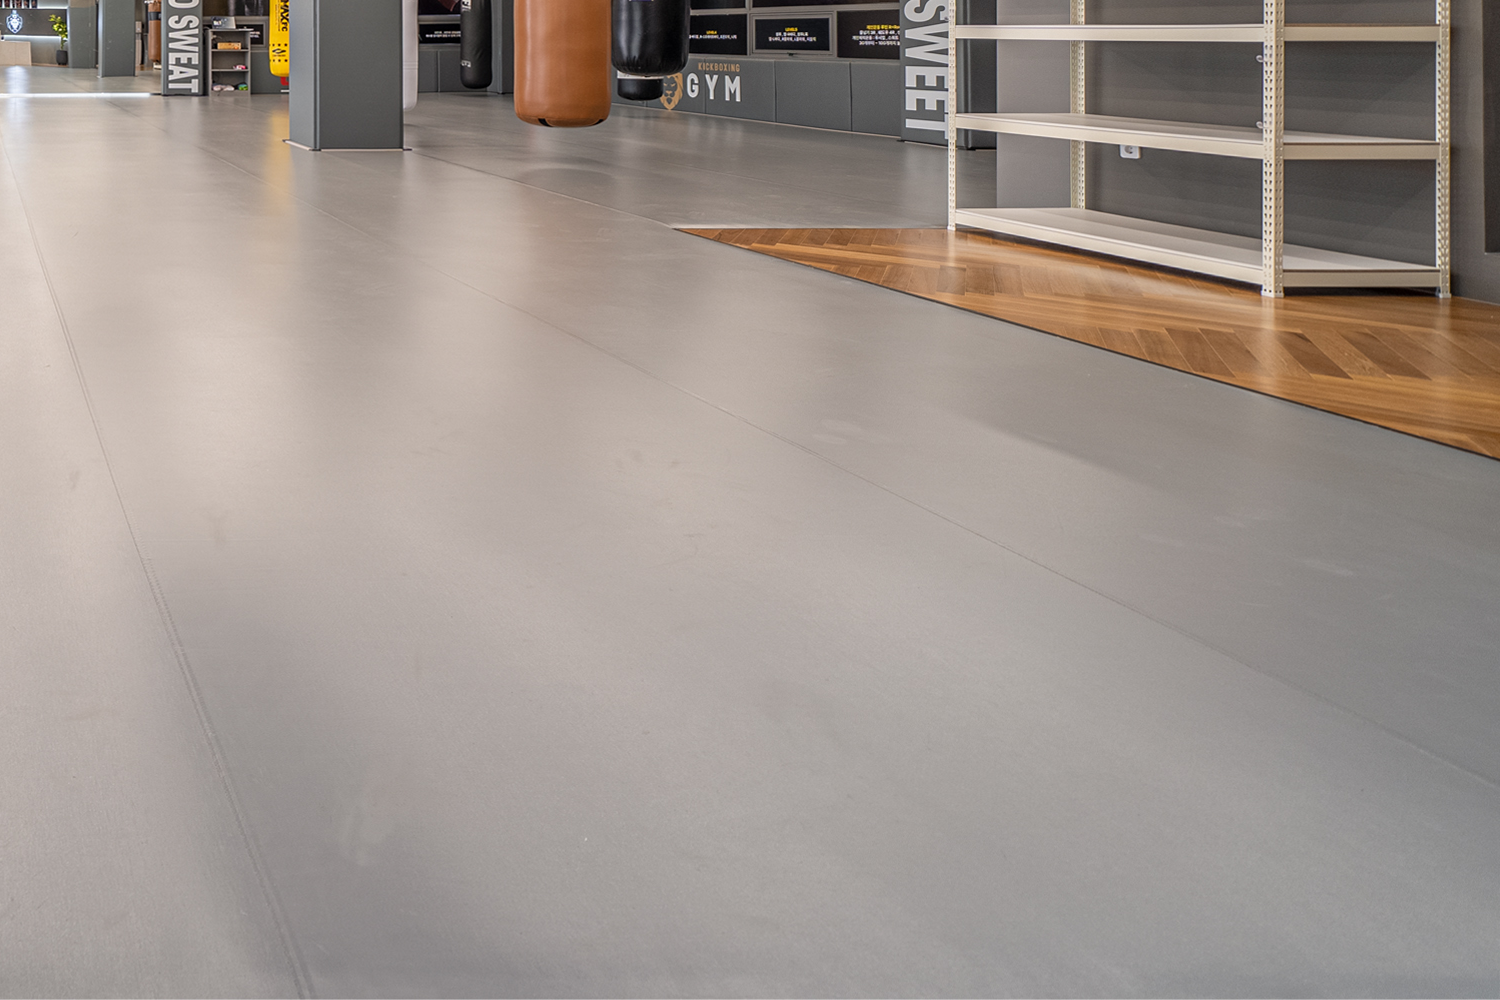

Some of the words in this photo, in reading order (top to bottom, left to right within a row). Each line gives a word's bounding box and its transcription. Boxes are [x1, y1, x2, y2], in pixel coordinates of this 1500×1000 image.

[168, 15, 200, 93] SWEAT
[698, 62, 740, 72] KICKBOXING
[687, 72, 741, 102] GYM
